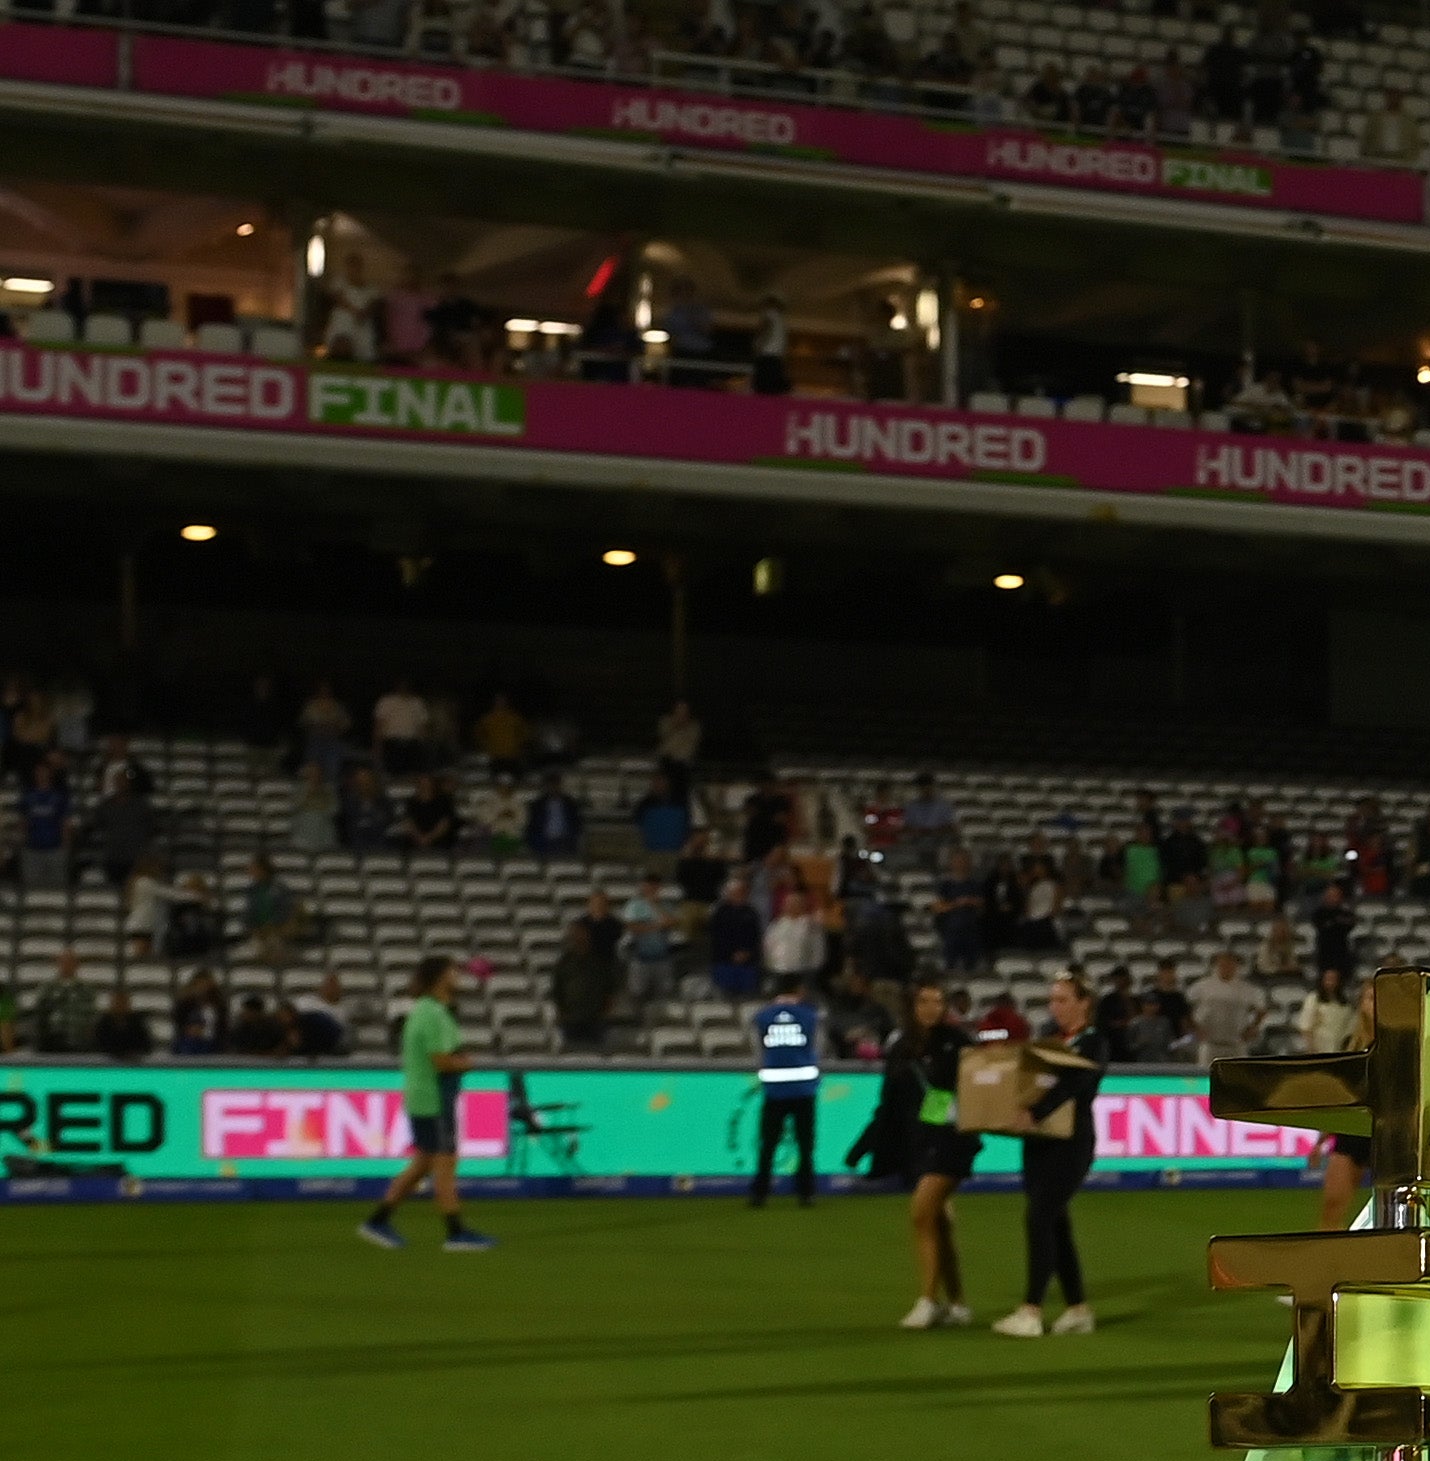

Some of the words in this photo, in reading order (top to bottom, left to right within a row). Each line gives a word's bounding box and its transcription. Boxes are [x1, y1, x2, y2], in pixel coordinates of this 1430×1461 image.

[266, 61, 461, 110] HUNDRED
[612, 96, 796, 145] HUNDRED
[986, 139, 1156, 183] HUNDRED
[0, 349, 294, 420] UNDRED
[309, 372, 523, 435] FINAL
[784, 411, 1046, 473] HUNDRED
[205, 1094, 506, 1156] FINL
